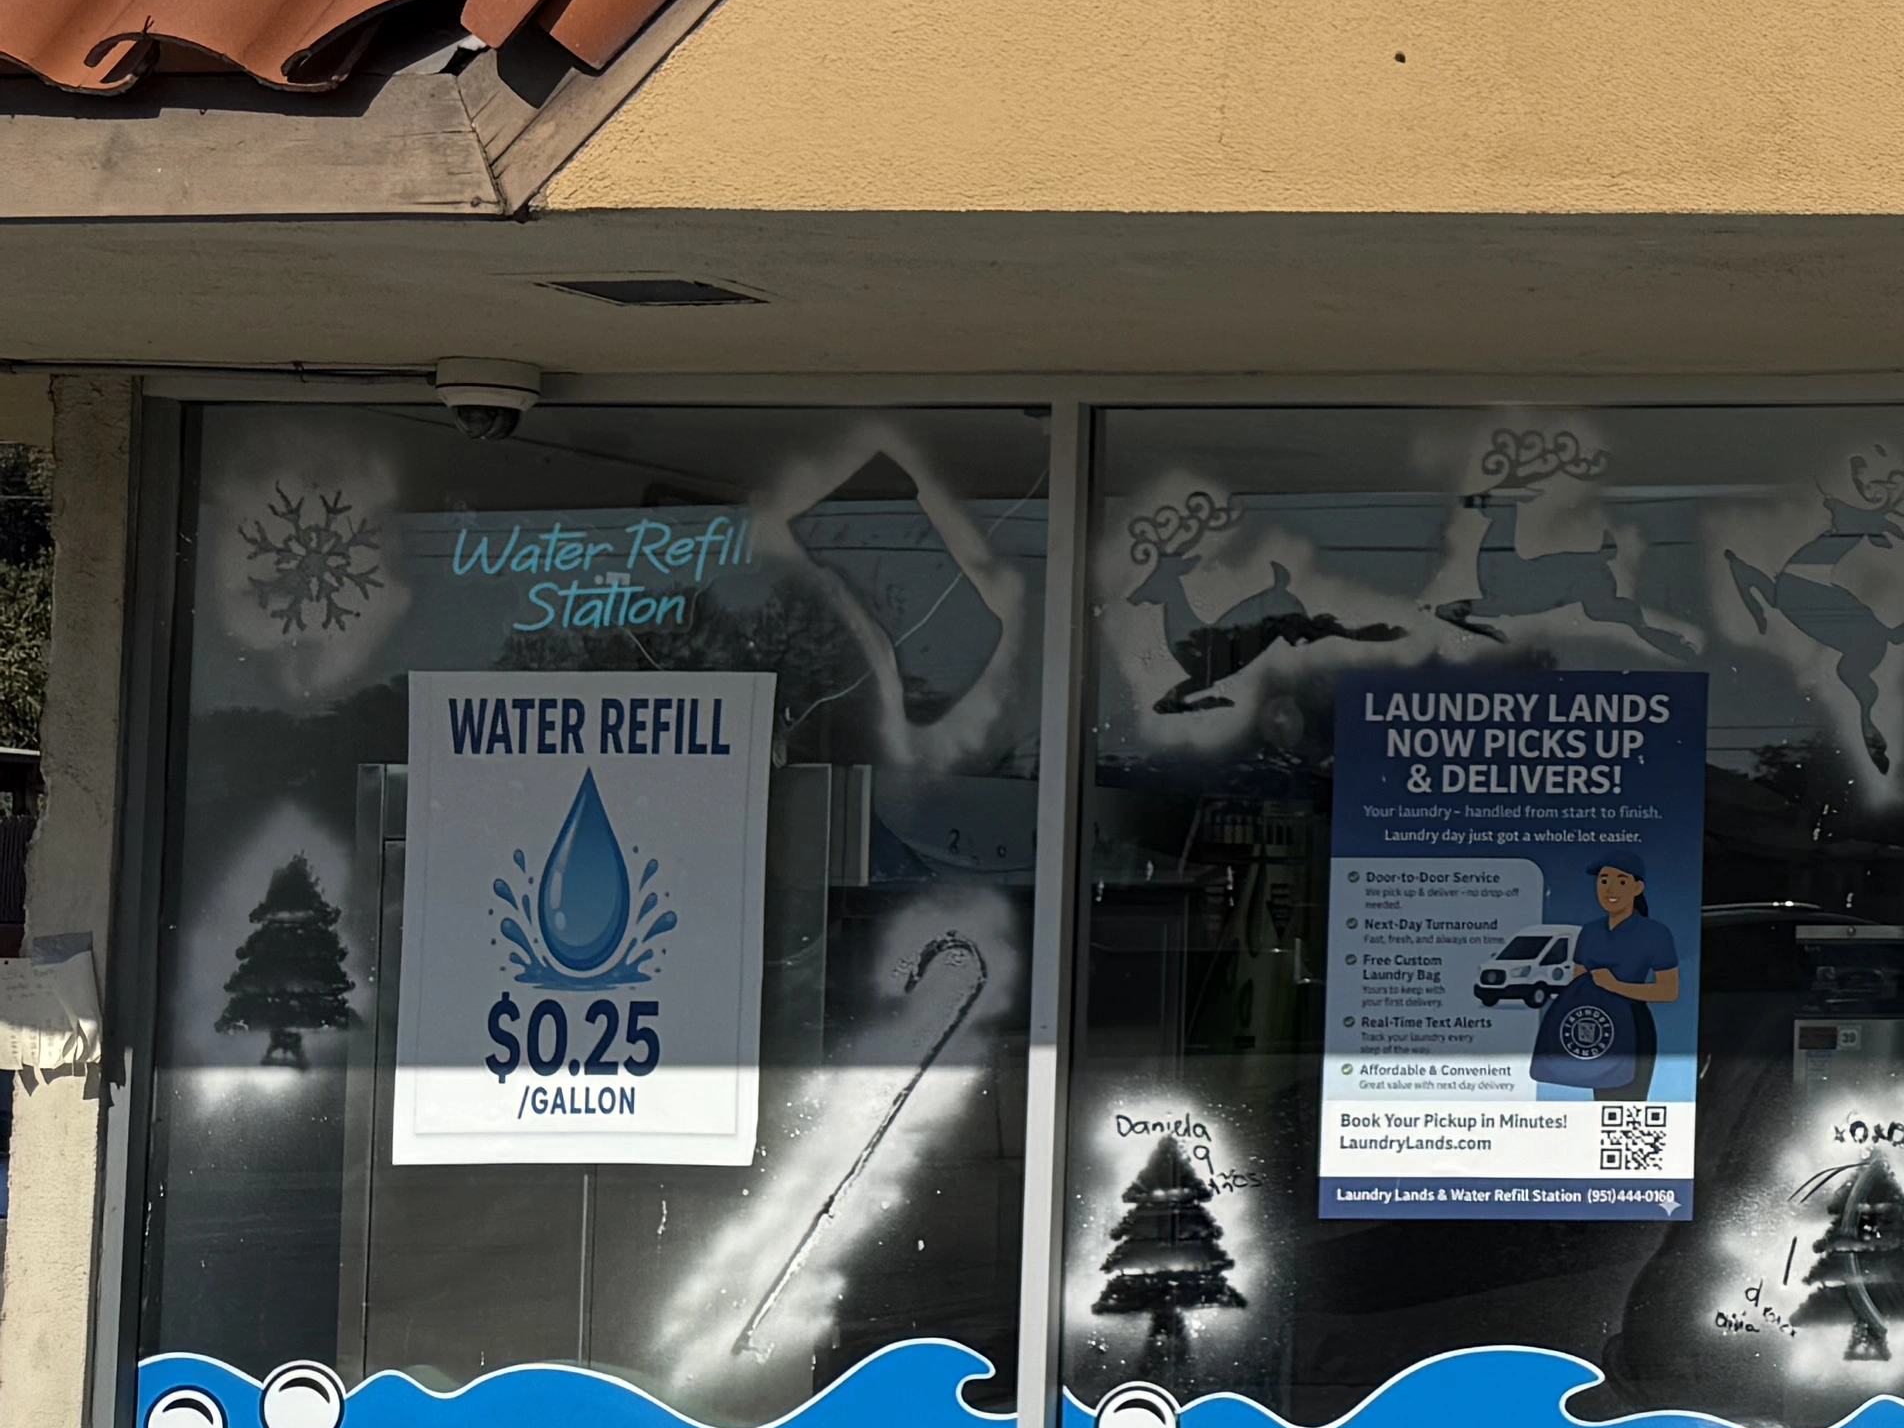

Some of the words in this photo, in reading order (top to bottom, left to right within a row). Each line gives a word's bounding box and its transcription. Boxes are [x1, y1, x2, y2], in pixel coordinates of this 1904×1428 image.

[453, 525, 614, 575] Water
[625, 516, 754, 580] Refill
[513, 583, 685, 632] Station
[1365, 693, 1539, 722] LAUNDRY
[1549, 694, 1669, 723] LANDS
[449, 698, 586, 755] WATER
[599, 698, 730, 757] REFILL
[1387, 729, 1475, 757] NOW
[1485, 729, 1587, 758] PICKS
[1596, 730, 1643, 758] UP
[1407, 764, 1432, 794] &
[1442, 765, 1622, 794] DELIVERS!
[1385, 829, 1438, 843] Laundry
[1442, 830, 1465, 844] day
[1468, 830, 1493, 843] just
[1497, 831, 1519, 844] got
[1523, 833, 1531, 842] a
[1534, 830, 1575, 842] whole
[1577, 830, 1595, 842] lot
[1600, 831, 1641, 842] easier.
[1366, 872, 1449, 883] Door-to-Door
[1454, 872, 1500, 883] Service
[1365, 919, 1423, 932] Next-Day
[1426, 919, 1498, 930] Turnaround
[1363, 955, 1391, 965] Free
[1395, 955, 1442, 966] Custom
[1363, 970, 1413, 982] Laundry
[1417, 970, 1441, 983] Bag
[1361, 1017, 1423, 1029] Real-Time
[1426, 1017, 1452, 1029] Text
[1454, 1017, 1492, 1029] Alerts
[486, 993, 661, 1084] $0.25
[1841, 1031, 1856, 1044] 39
[1360, 1064, 1427, 1076] Affordable
[1429, 1065, 1437, 1076] &
[1441, 1064, 1511, 1077] Convenient
[517, 1085, 636, 1119] /GALLON
[1116, 1113, 1212, 1142] Daniela
[1341, 1114, 1380, 1128] Book
[1384, 1114, 1420, 1129] Your
[1424, 1114, 1477, 1132] Pickup
[1481, 1114, 1495, 1129] in
[1500, 1114, 1567, 1129] Minutes!
[1340, 1136, 1491, 1153] LaundryLands.com
[1337, 1188, 1391, 1204] Laundry
[1395, 1189, 1434, 1202] Lands
[1438, 1189, 1447, 1201] &
[1451, 1189, 1490, 1202] Water
[1495, 1189, 1529, 1202] Refill
[1533, 1190, 1581, 1203] Station
